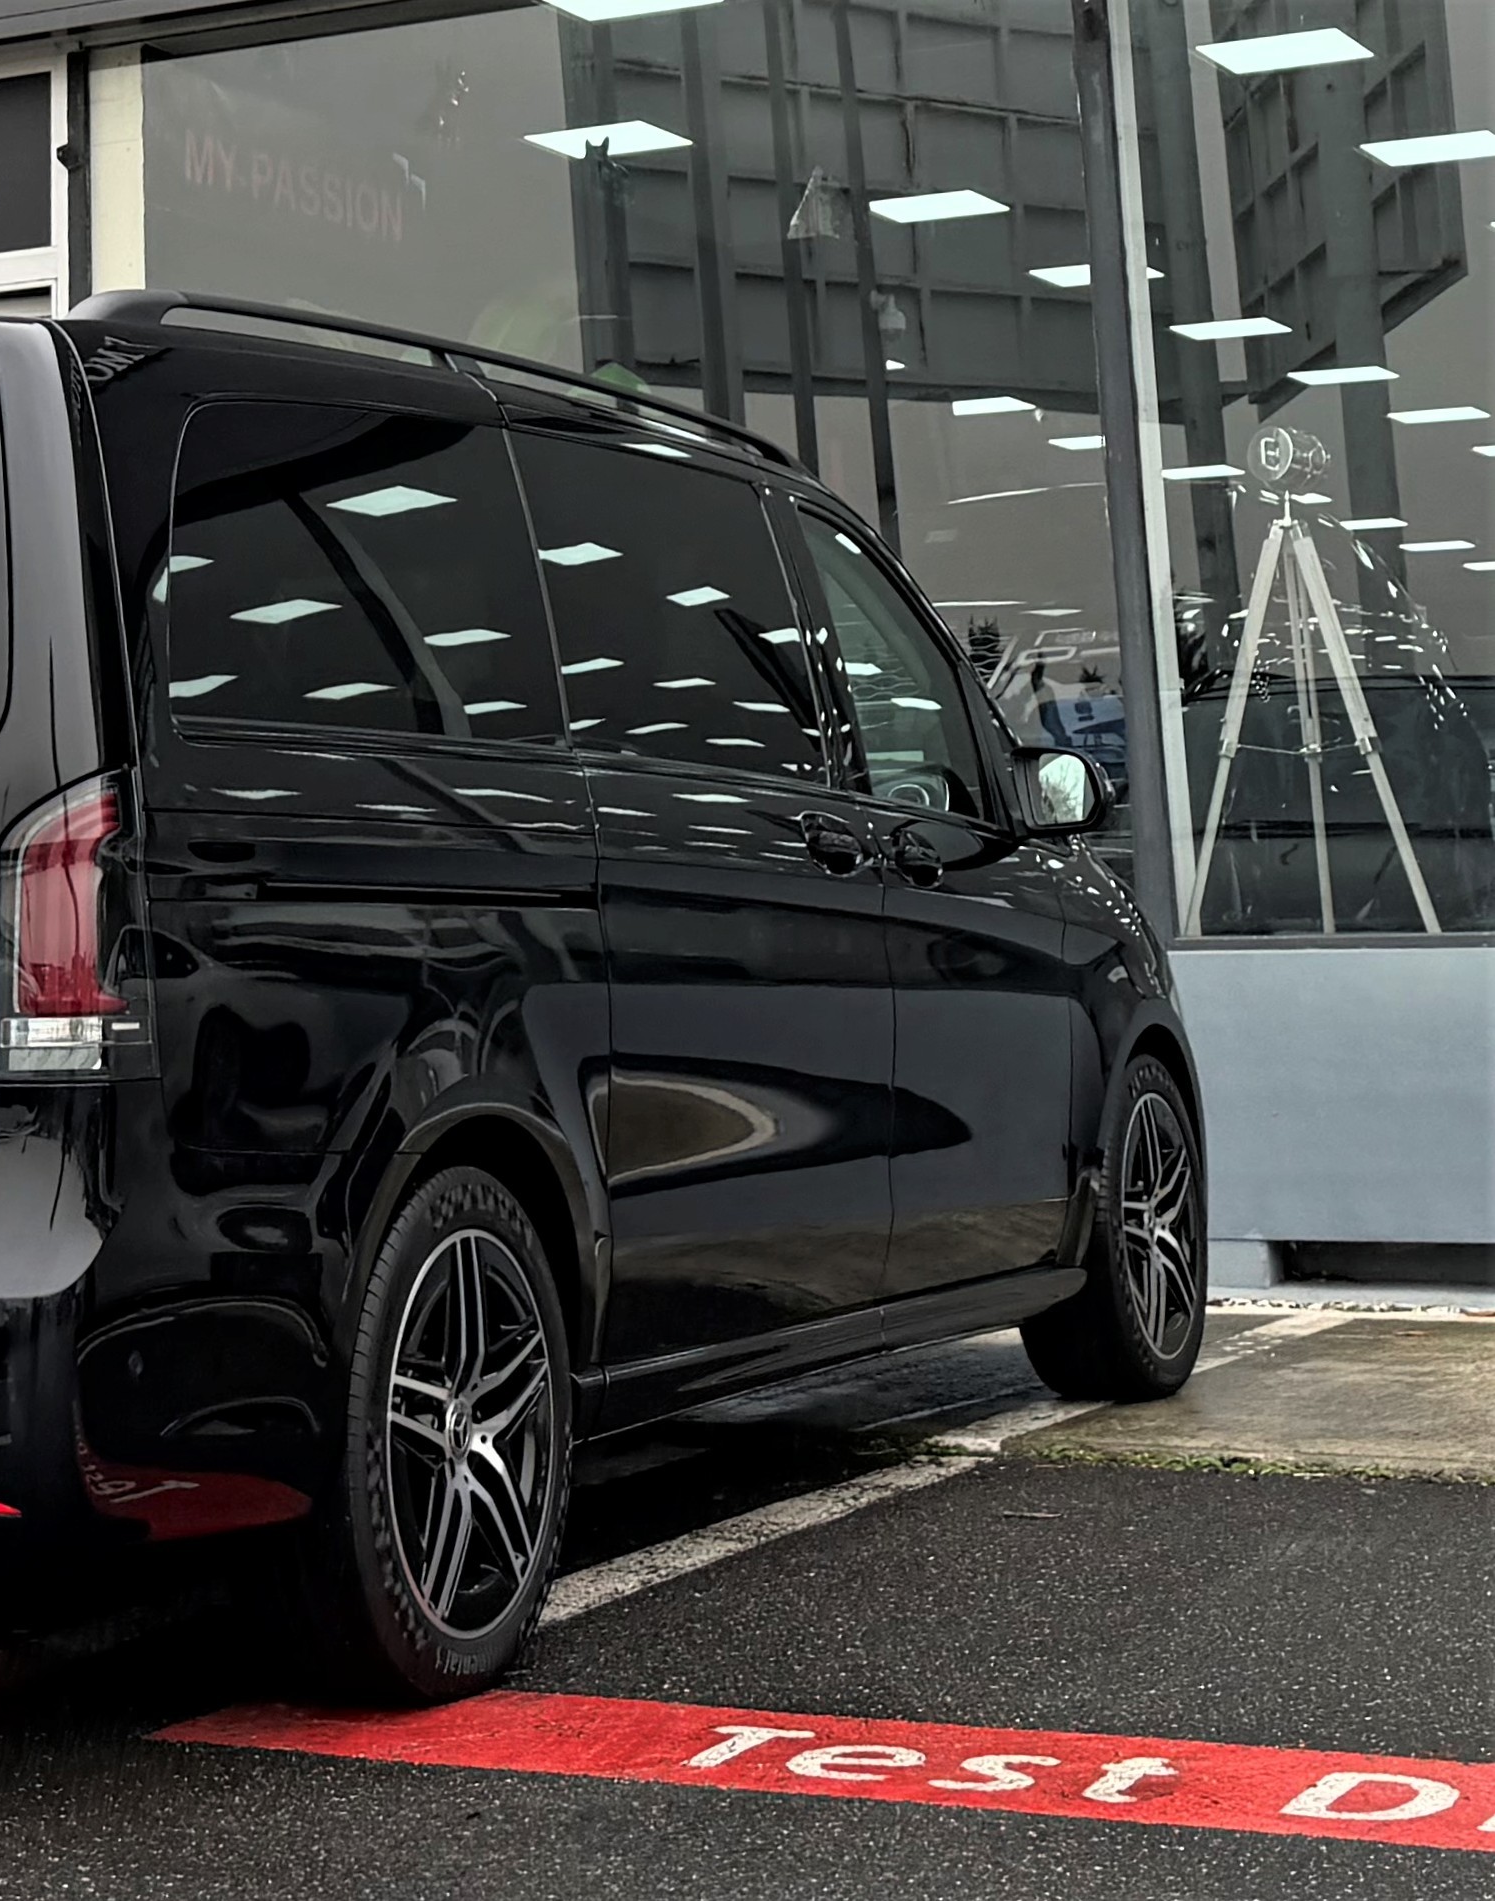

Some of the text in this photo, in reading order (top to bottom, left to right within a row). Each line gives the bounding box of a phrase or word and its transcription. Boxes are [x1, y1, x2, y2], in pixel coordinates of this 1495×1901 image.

[186, 128, 404, 243] MY PASSION
[679, 1725, 1495, 1832] Test D
